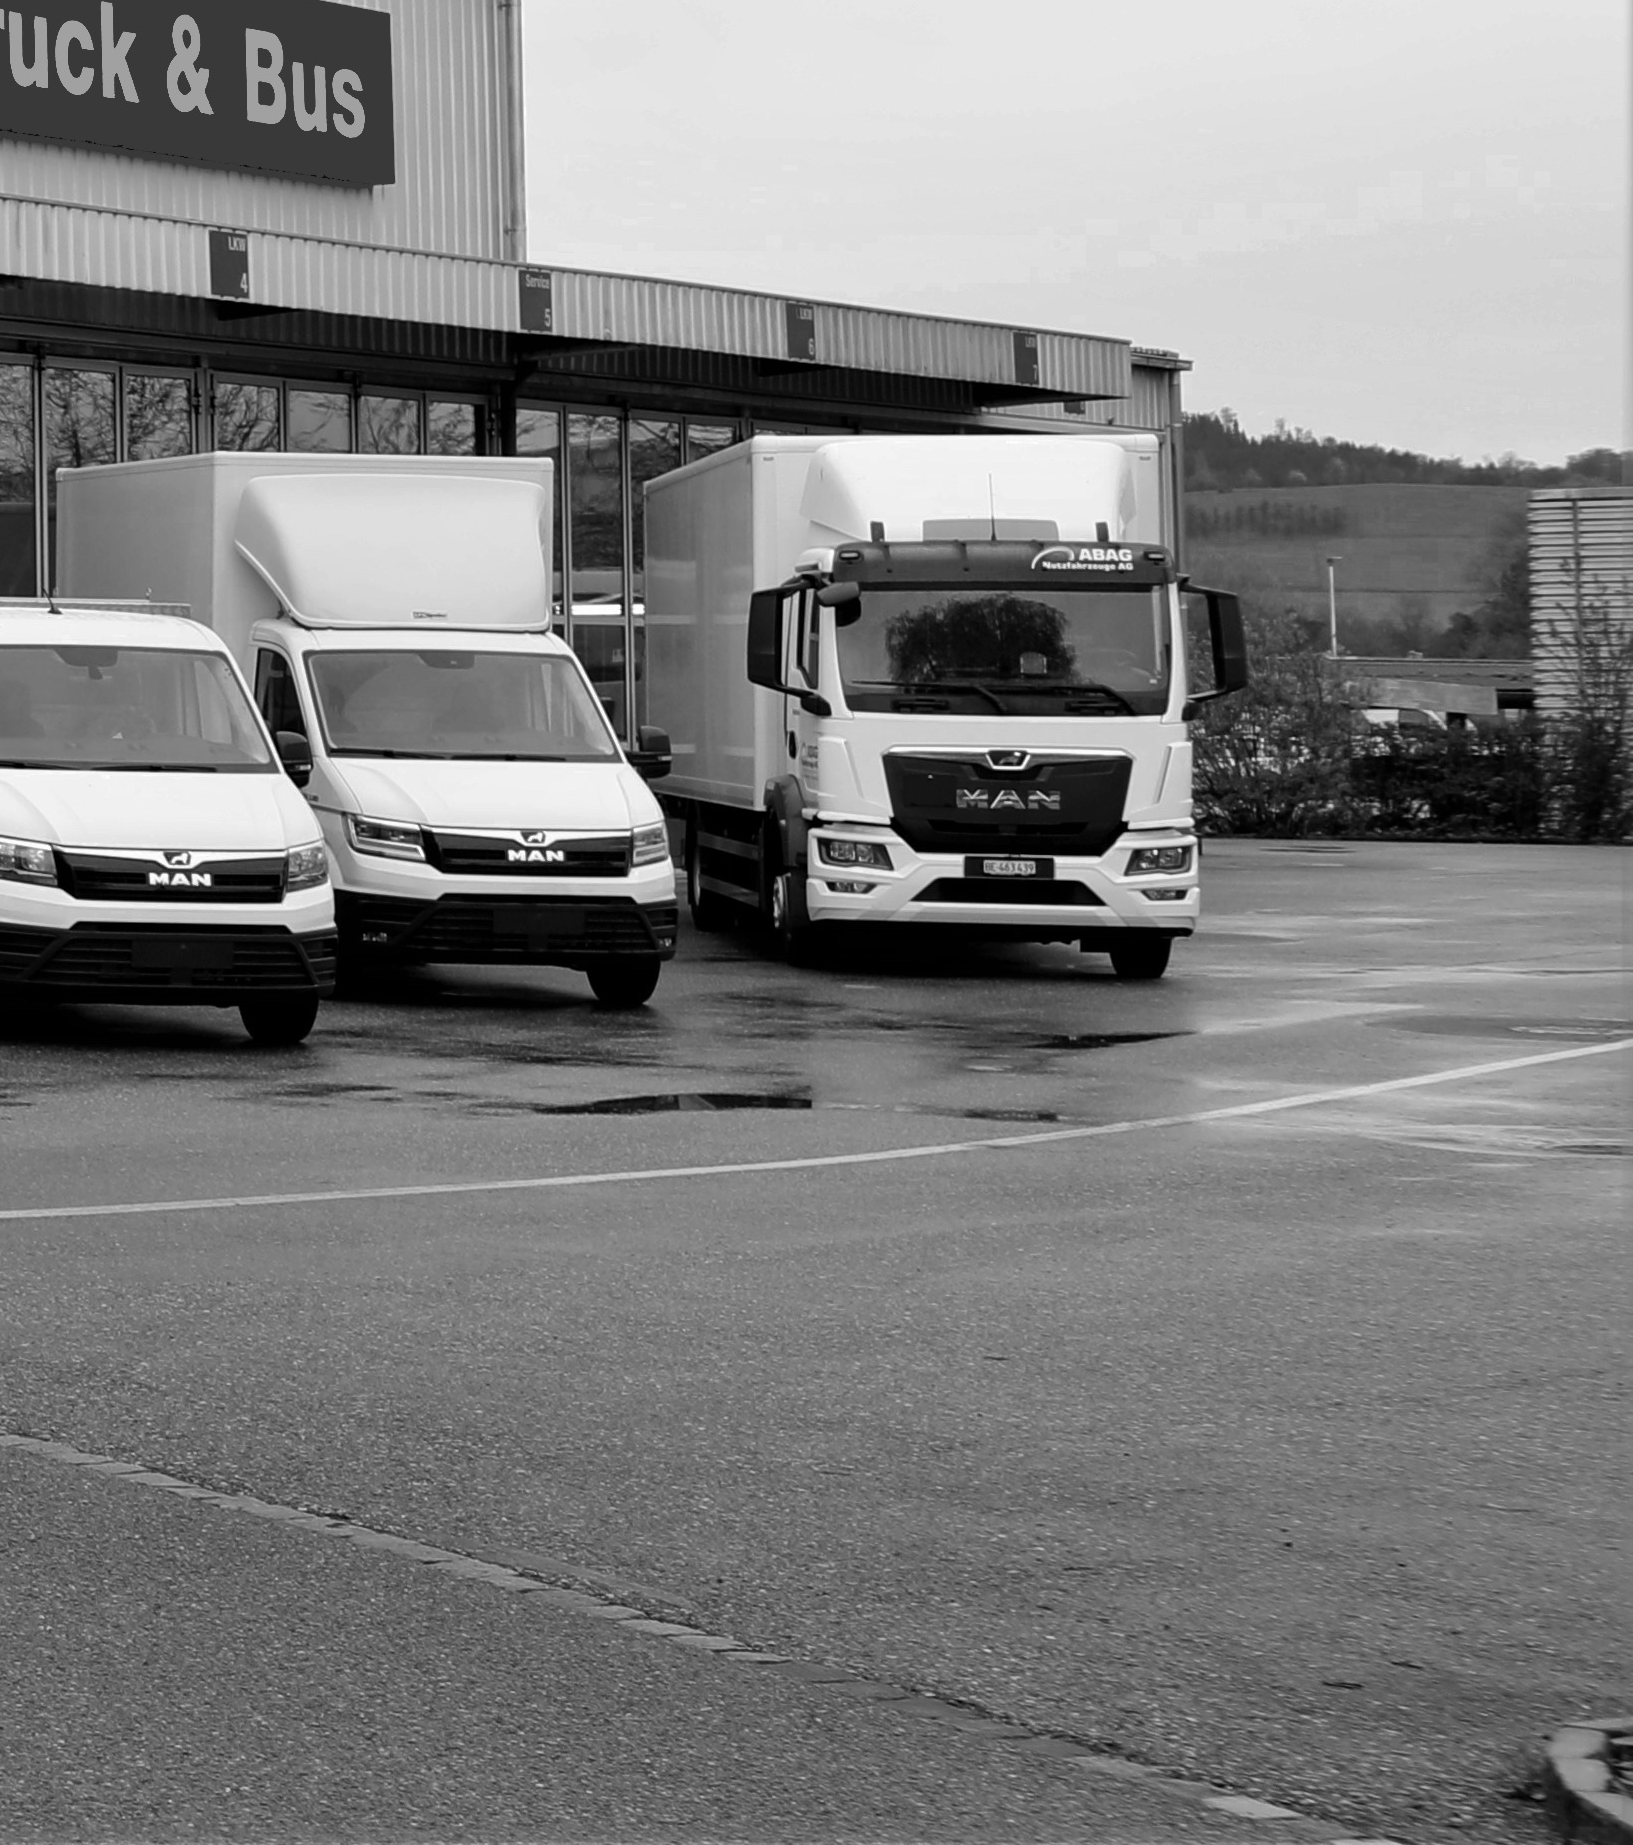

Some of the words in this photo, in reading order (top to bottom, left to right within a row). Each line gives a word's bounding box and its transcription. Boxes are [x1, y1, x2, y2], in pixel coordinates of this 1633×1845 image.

[166, 13, 214, 116] &
[245, 27, 366, 139] Bus
[228, 235, 246, 252] LKW
[240, 272, 248, 294] 4
[544, 307, 551, 327] 5
[808, 338, 814, 355] 6
[1078, 548, 1133, 562] ABAG
[956, 789, 1061, 810] MAN
[507, 849, 565, 862] MAN
[148, 872, 212, 887] MAN
